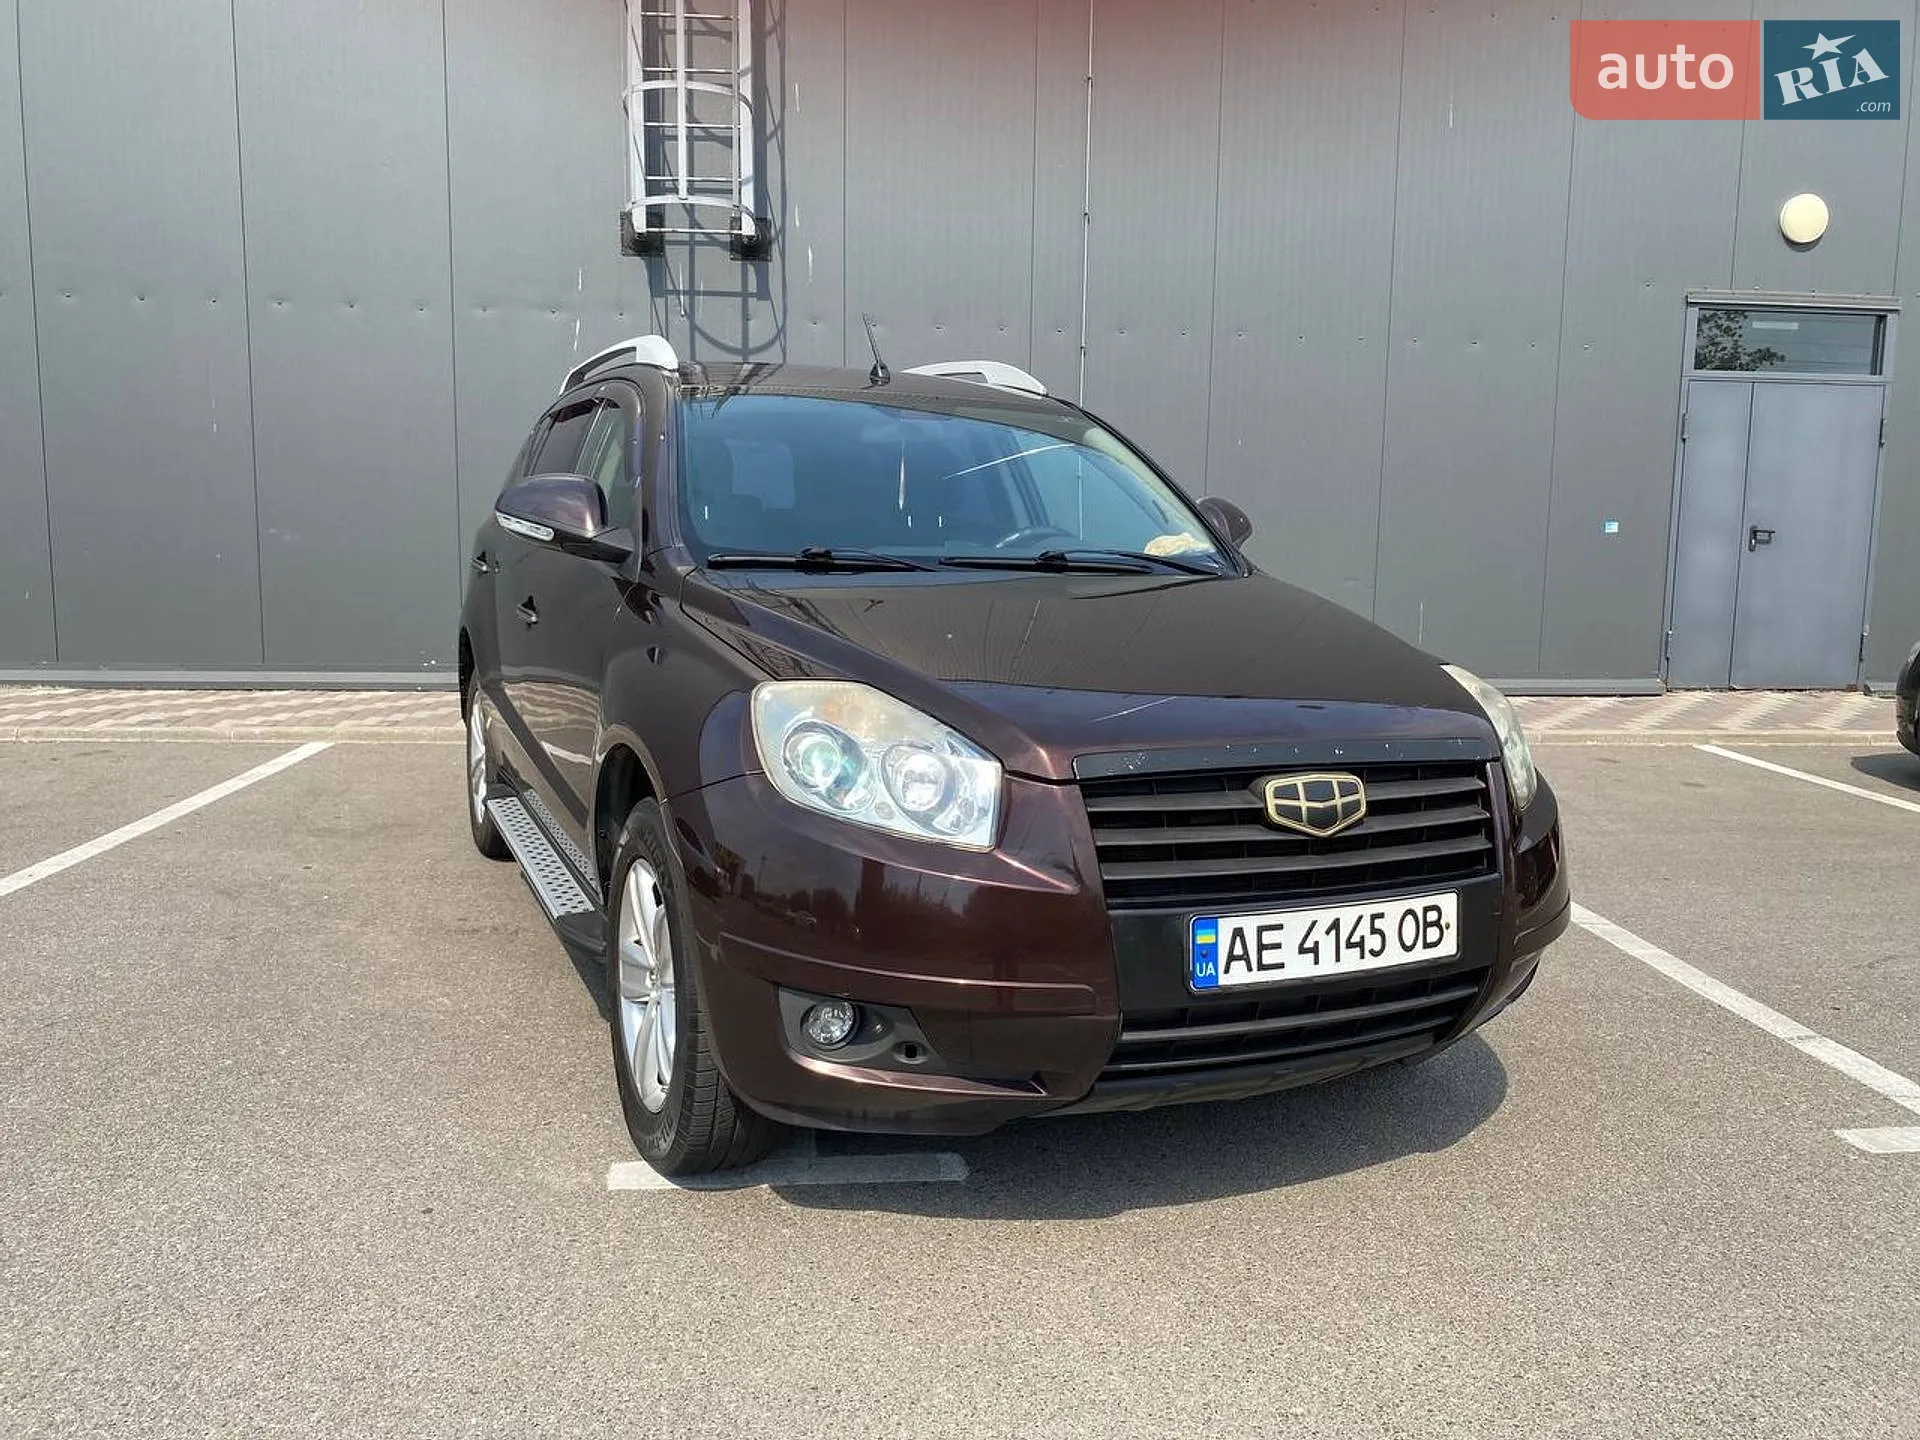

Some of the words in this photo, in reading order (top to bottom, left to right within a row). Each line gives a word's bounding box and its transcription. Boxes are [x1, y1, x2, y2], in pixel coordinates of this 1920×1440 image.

[1223, 923, 1285, 974] AE
[1297, 912, 1387, 965] 4145
[1398, 904, 1444, 952] OB
[1196, 963, 1216, 977] UA
